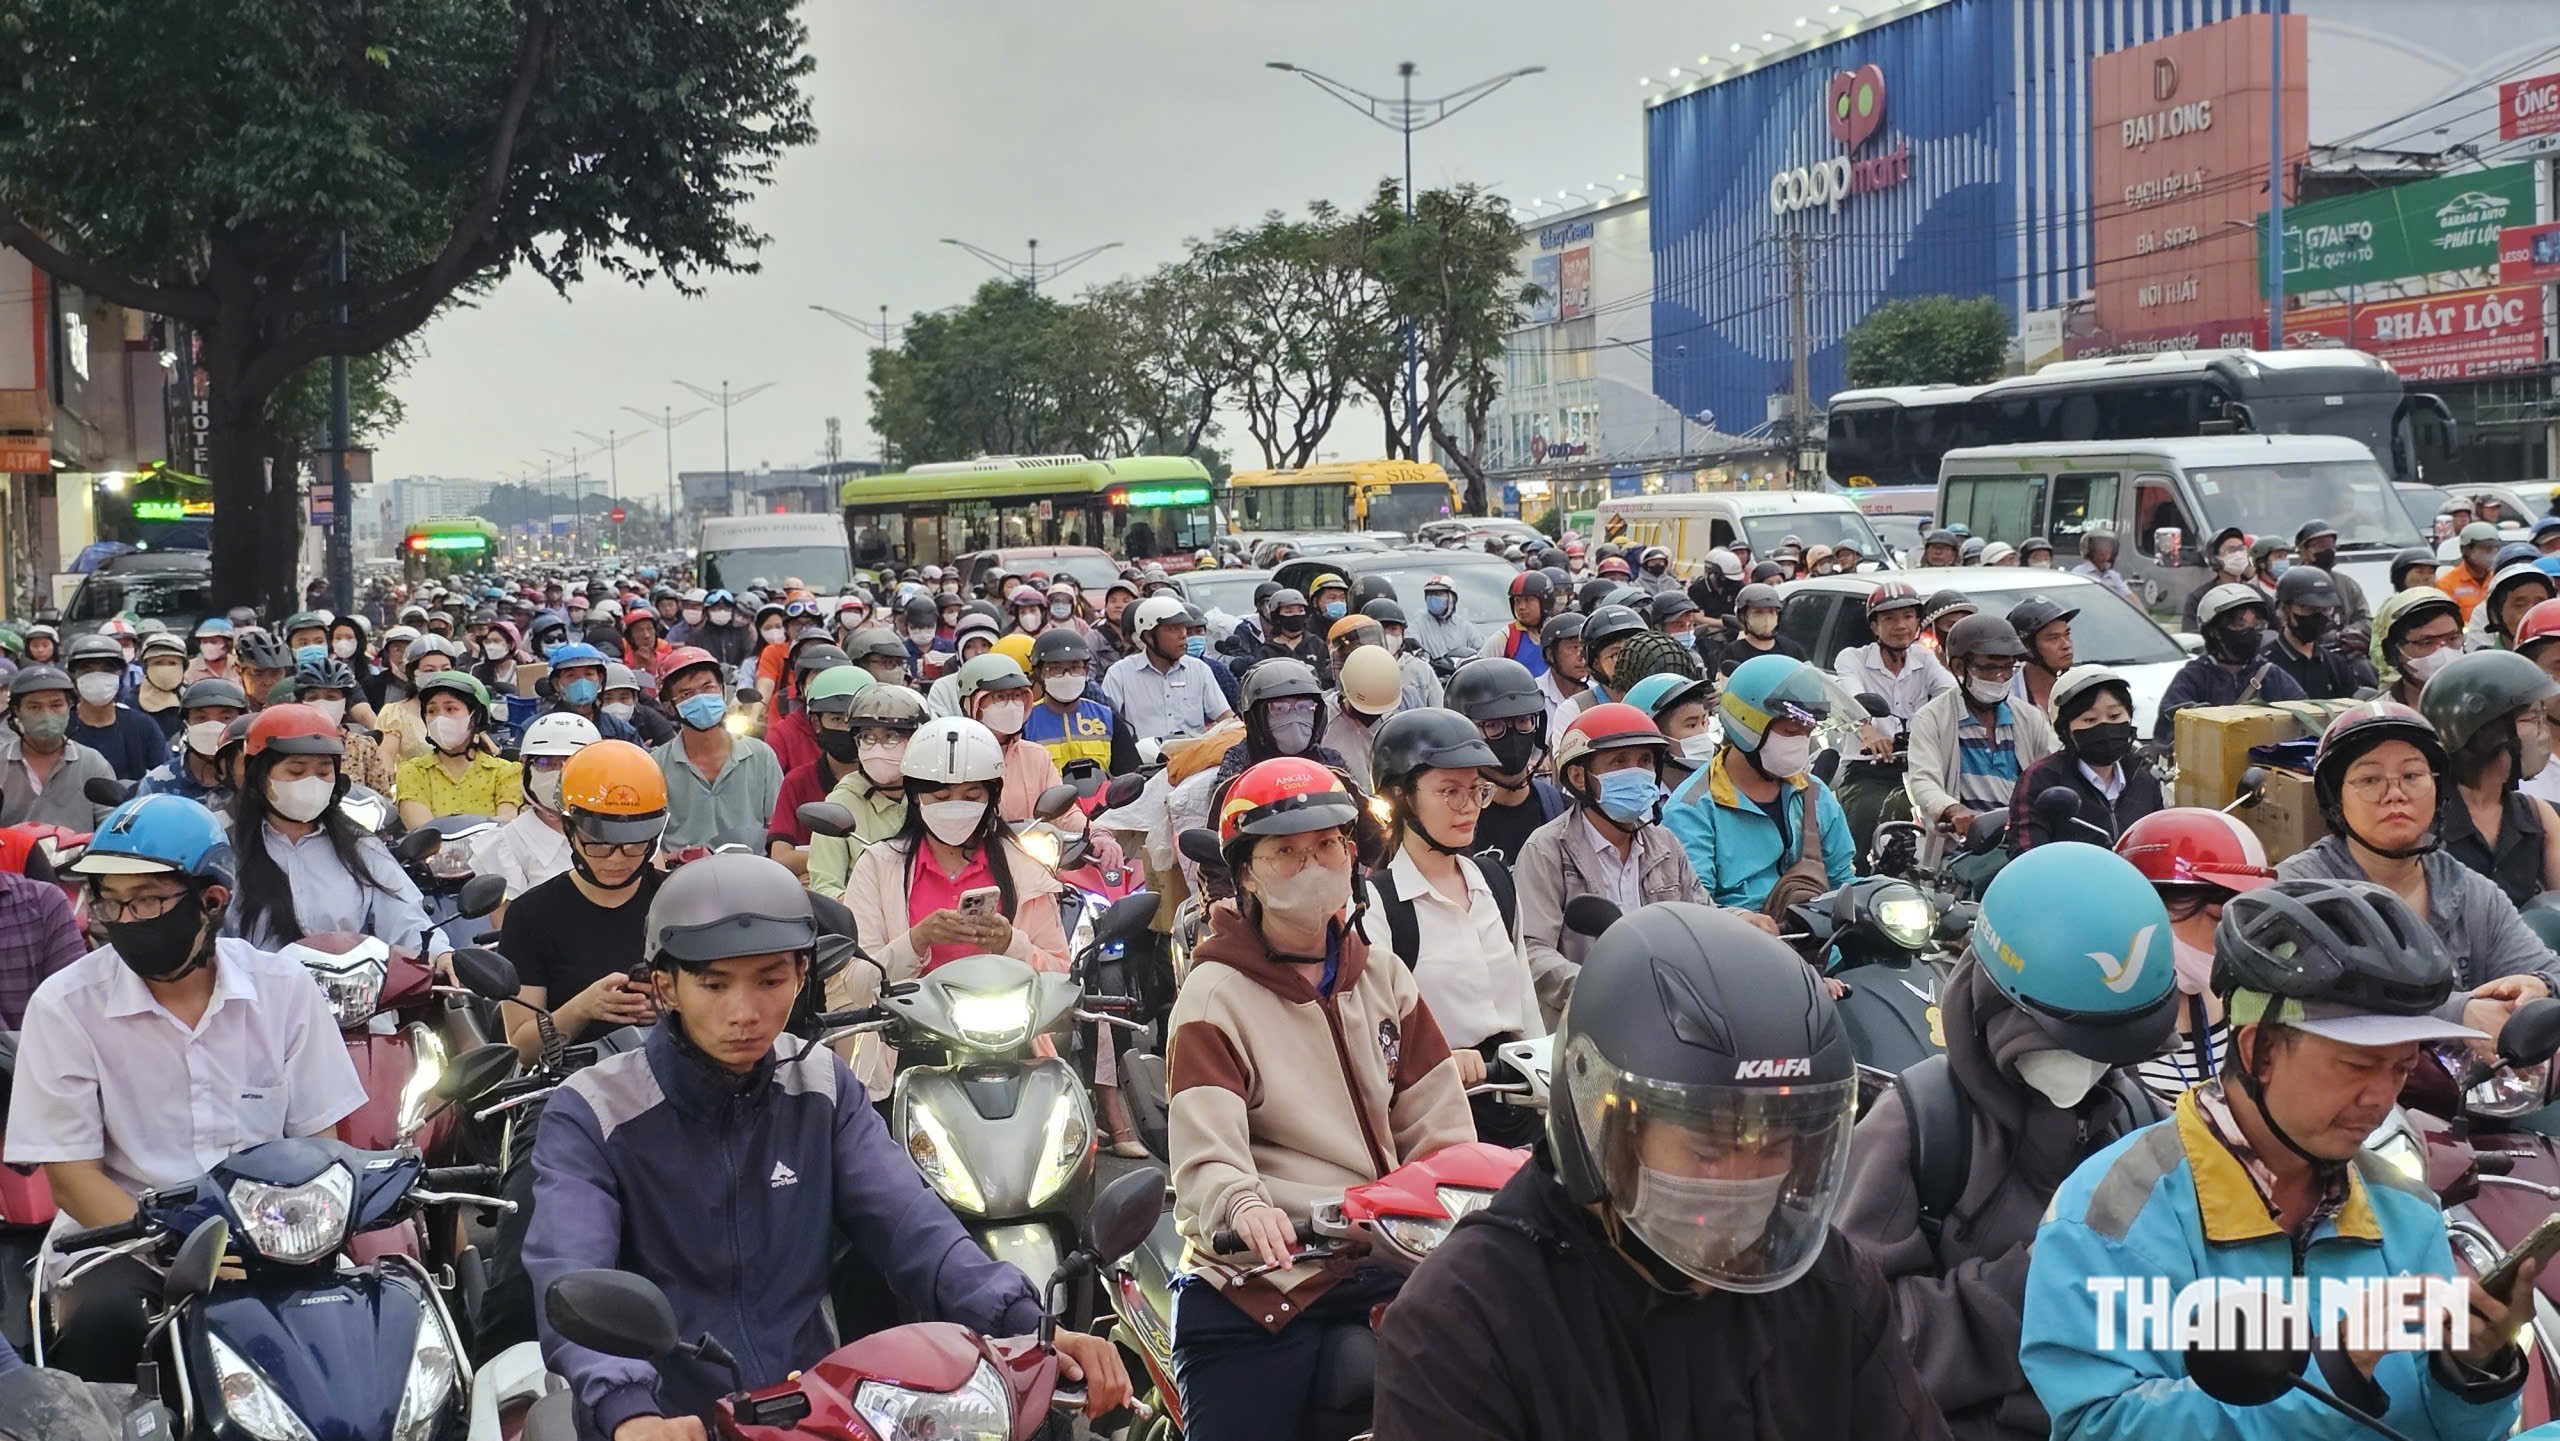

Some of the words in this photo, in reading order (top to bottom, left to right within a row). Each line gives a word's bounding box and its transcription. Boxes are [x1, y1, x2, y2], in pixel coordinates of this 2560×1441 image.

[2122, 115, 2155, 153] ĐẠI
[2158, 100, 2212, 140] LONG
[2440, 211, 2479, 228] GARAGE
[2480, 207, 2507, 221] AUTO
[2442, 227, 2477, 249] PHÁT
[2500, 249, 2529, 263] LESSO
[2375, 304, 2456, 341] PHÁT
[2464, 294, 2525, 337] LỘC
[2420, 363, 2459, 380] 24/24
[192, 400, 210, 477] HOTEL
[6, 452, 42, 470] ATM
[1386, 468, 1427, 481] SBS
[1076, 712, 1107, 736] be
[301, 1294, 350, 1306] HONDA
